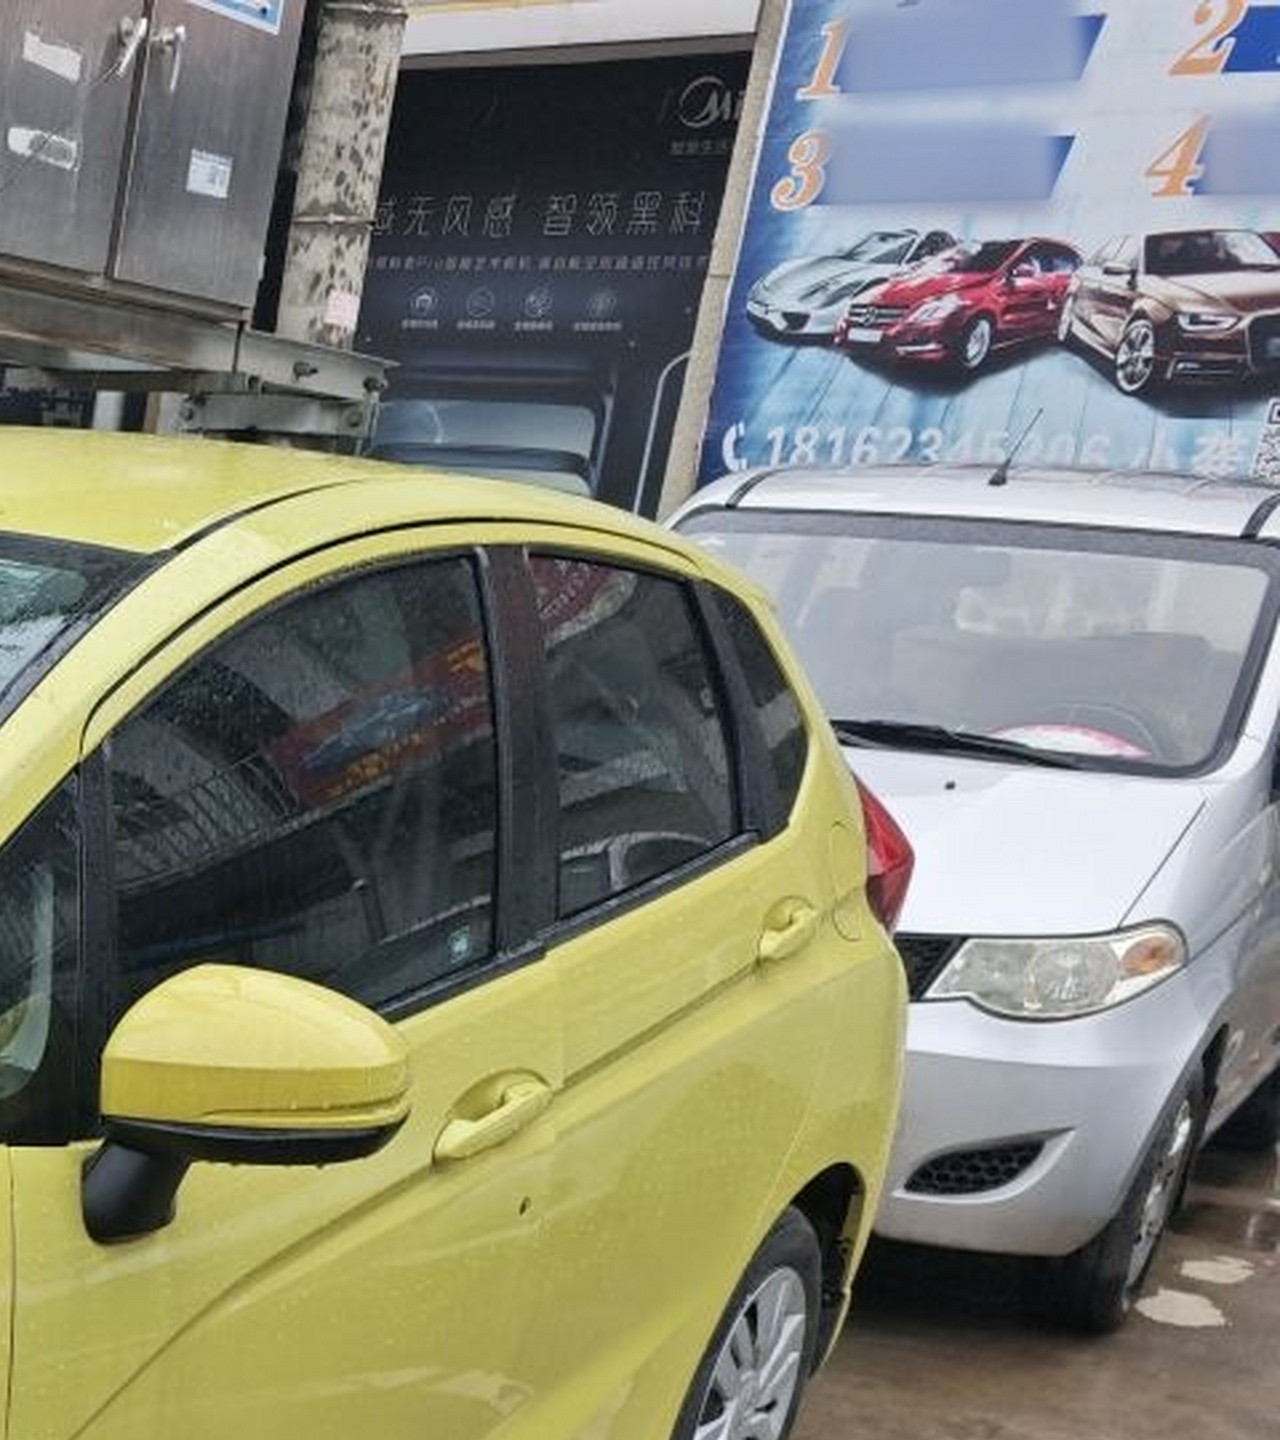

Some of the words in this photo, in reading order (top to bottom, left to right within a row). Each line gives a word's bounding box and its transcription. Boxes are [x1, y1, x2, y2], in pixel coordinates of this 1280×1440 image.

[796, 18, 846, 101] 1
[1168, 0, 1248, 76] 2
[771, 129, 832, 211] 3
[1145, 112, 1211, 197] 4
